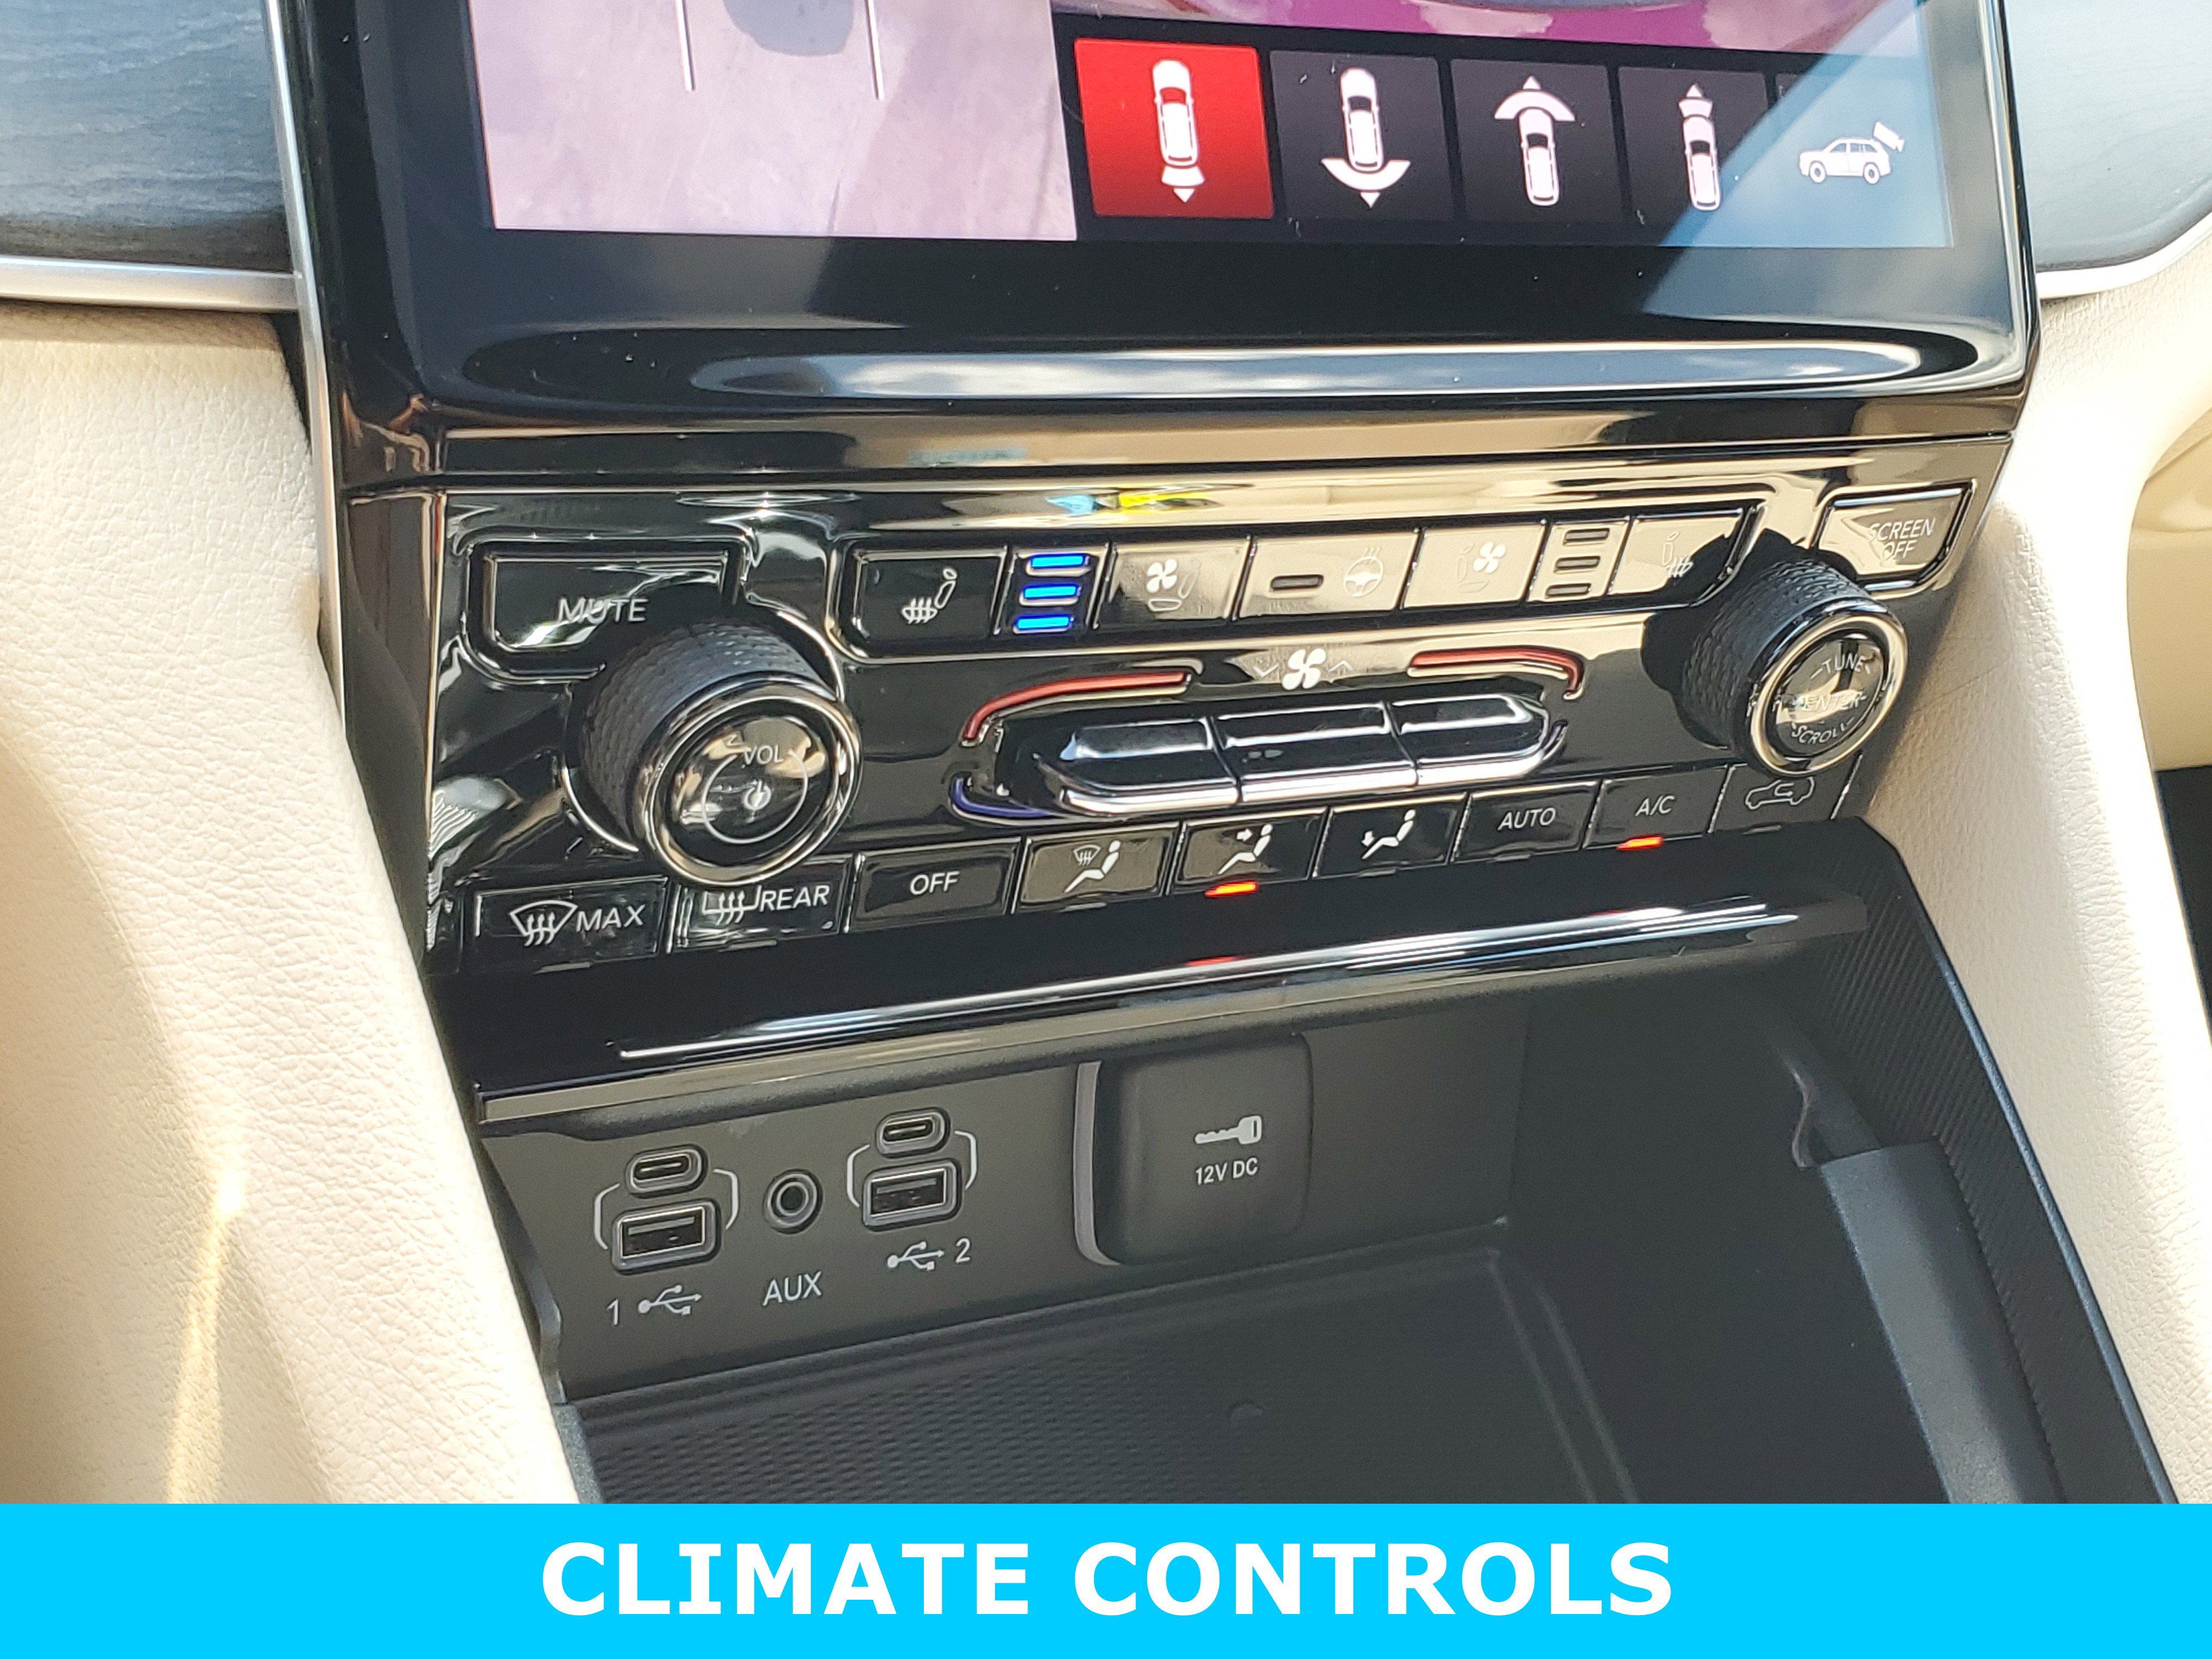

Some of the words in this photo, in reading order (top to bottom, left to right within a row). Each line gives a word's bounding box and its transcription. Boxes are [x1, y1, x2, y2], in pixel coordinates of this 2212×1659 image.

[1869, 517, 1936, 541] SCREEN
[1882, 539, 1918, 561] OFF
[557, 598, 648, 623] MUTE
[1822, 653, 1865, 674] TUNE
[1791, 723, 1846, 744] SCROLL
[744, 745, 783, 765] VOL
[1635, 796, 1675, 816] A/C
[1498, 808, 1556, 830] AUTO
[910, 872, 960, 895] OFF
[758, 885, 830, 911] REAR
[575, 905, 647, 931] MAX
[1195, 1163, 1227, 1185] 12V
[1233, 1157, 1258, 1178] DC
[956, 1238, 971, 1263] 2
[762, 1271, 823, 1306] AUX
[607, 1299, 619, 1326] 1
